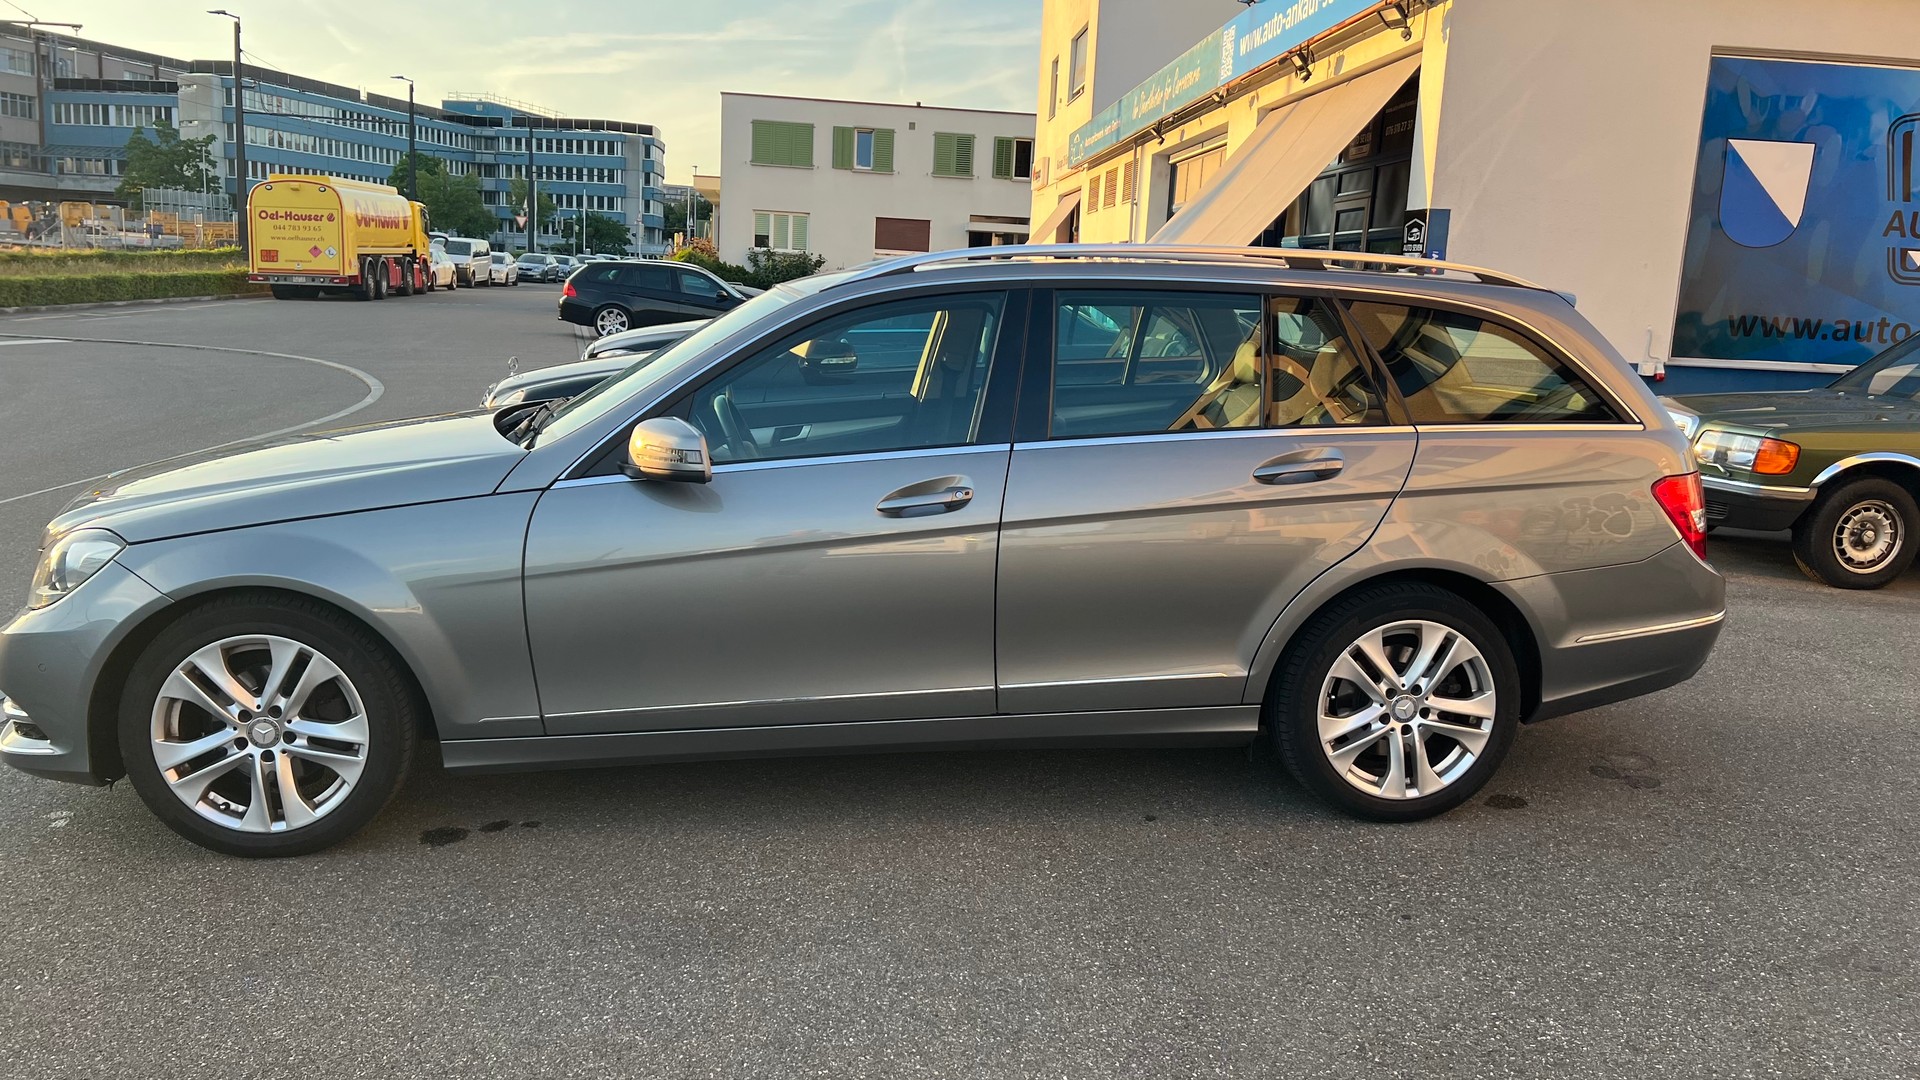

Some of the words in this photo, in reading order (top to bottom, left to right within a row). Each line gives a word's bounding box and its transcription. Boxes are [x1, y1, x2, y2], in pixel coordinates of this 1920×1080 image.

[1239, 0, 1334, 56] www.auto-ankauf-s
[258, 209, 325, 222] Oel-Hauser
[270, 234, 325, 242] www.oelhauser.ch
[1402, 243, 1412, 251] AUTO
[1412, 243, 1423, 251] SEVEN
